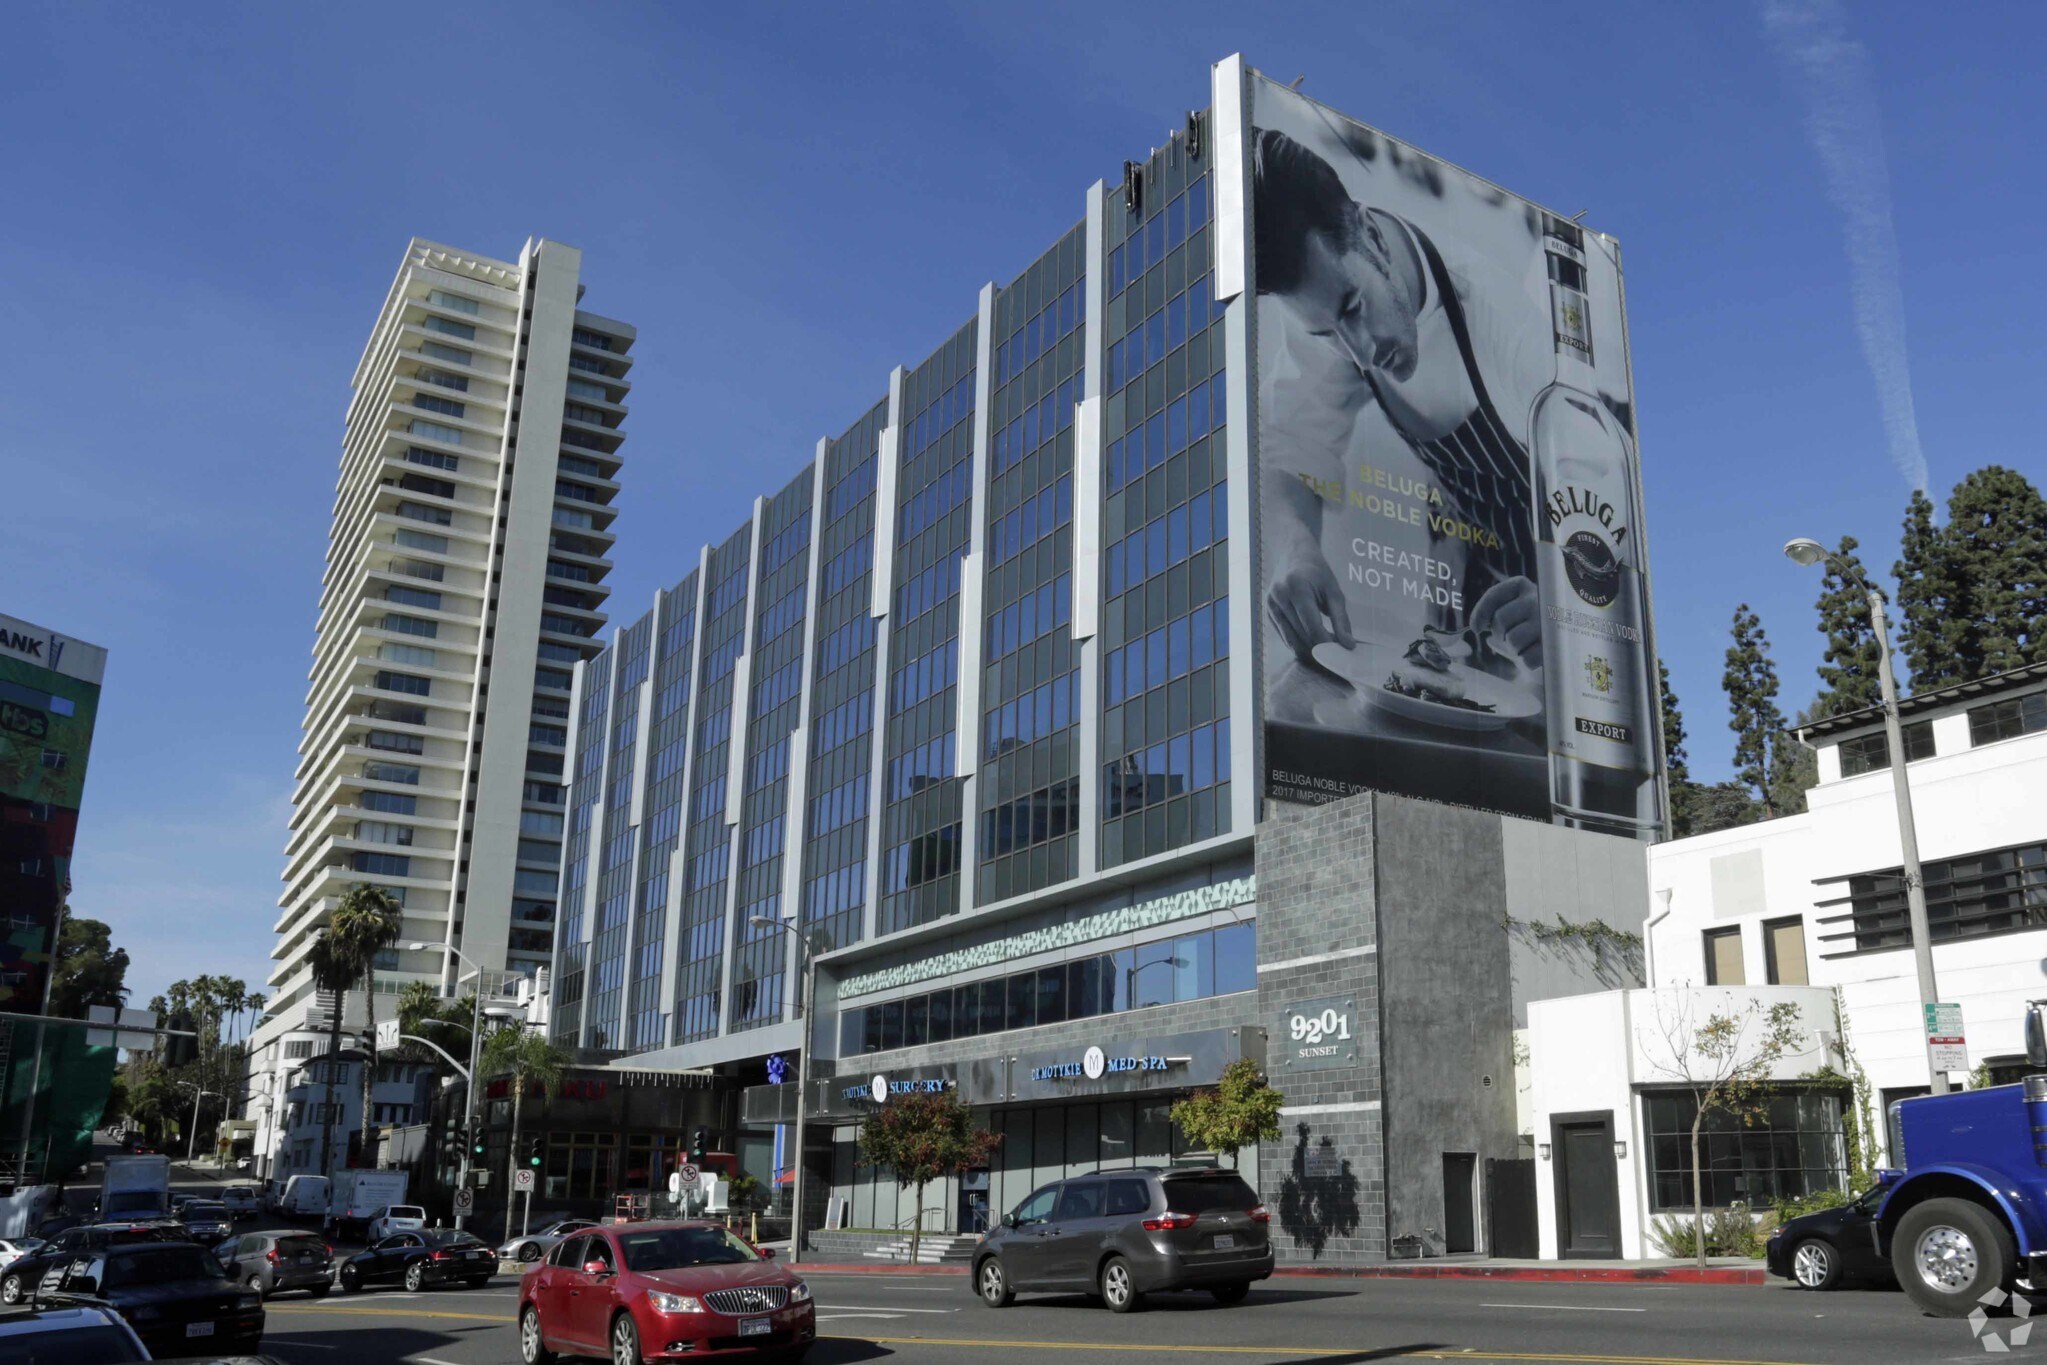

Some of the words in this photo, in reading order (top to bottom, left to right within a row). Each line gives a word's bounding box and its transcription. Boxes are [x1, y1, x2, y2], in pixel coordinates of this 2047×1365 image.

[1360, 464, 1443, 507] BELUGA
[1298, 472, 1341, 501] THE
[1351, 490, 1422, 526] NOBLE
[1428, 513, 1499, 549] VODKA
[1545, 486, 1627, 545] BELUGA
[1352, 537, 1456, 585] CREATED,
[1349, 562, 1394, 591] NOT
[1403, 580, 1463, 611] MADE
[1580, 588, 1608, 604] QUALITY
[1581, 720, 1626, 740] EXPORT
[1272, 769, 1311, 786] BELUGA
[1313, 777, 1346, 793] NOBLE
[1272, 785, 1294, 798] 2017
[1296, 789, 1345, 804] IMPORT
[1290, 1008, 1351, 1044] 9201
[1298, 1045, 1339, 1058] SUNSET
[1041, 1062, 1082, 1079] MOTYKIE
[1107, 1057, 1137, 1072] MED
[1141, 1056, 1168, 1070] SPA
[889, 1079, 945, 1094] SURGERY
